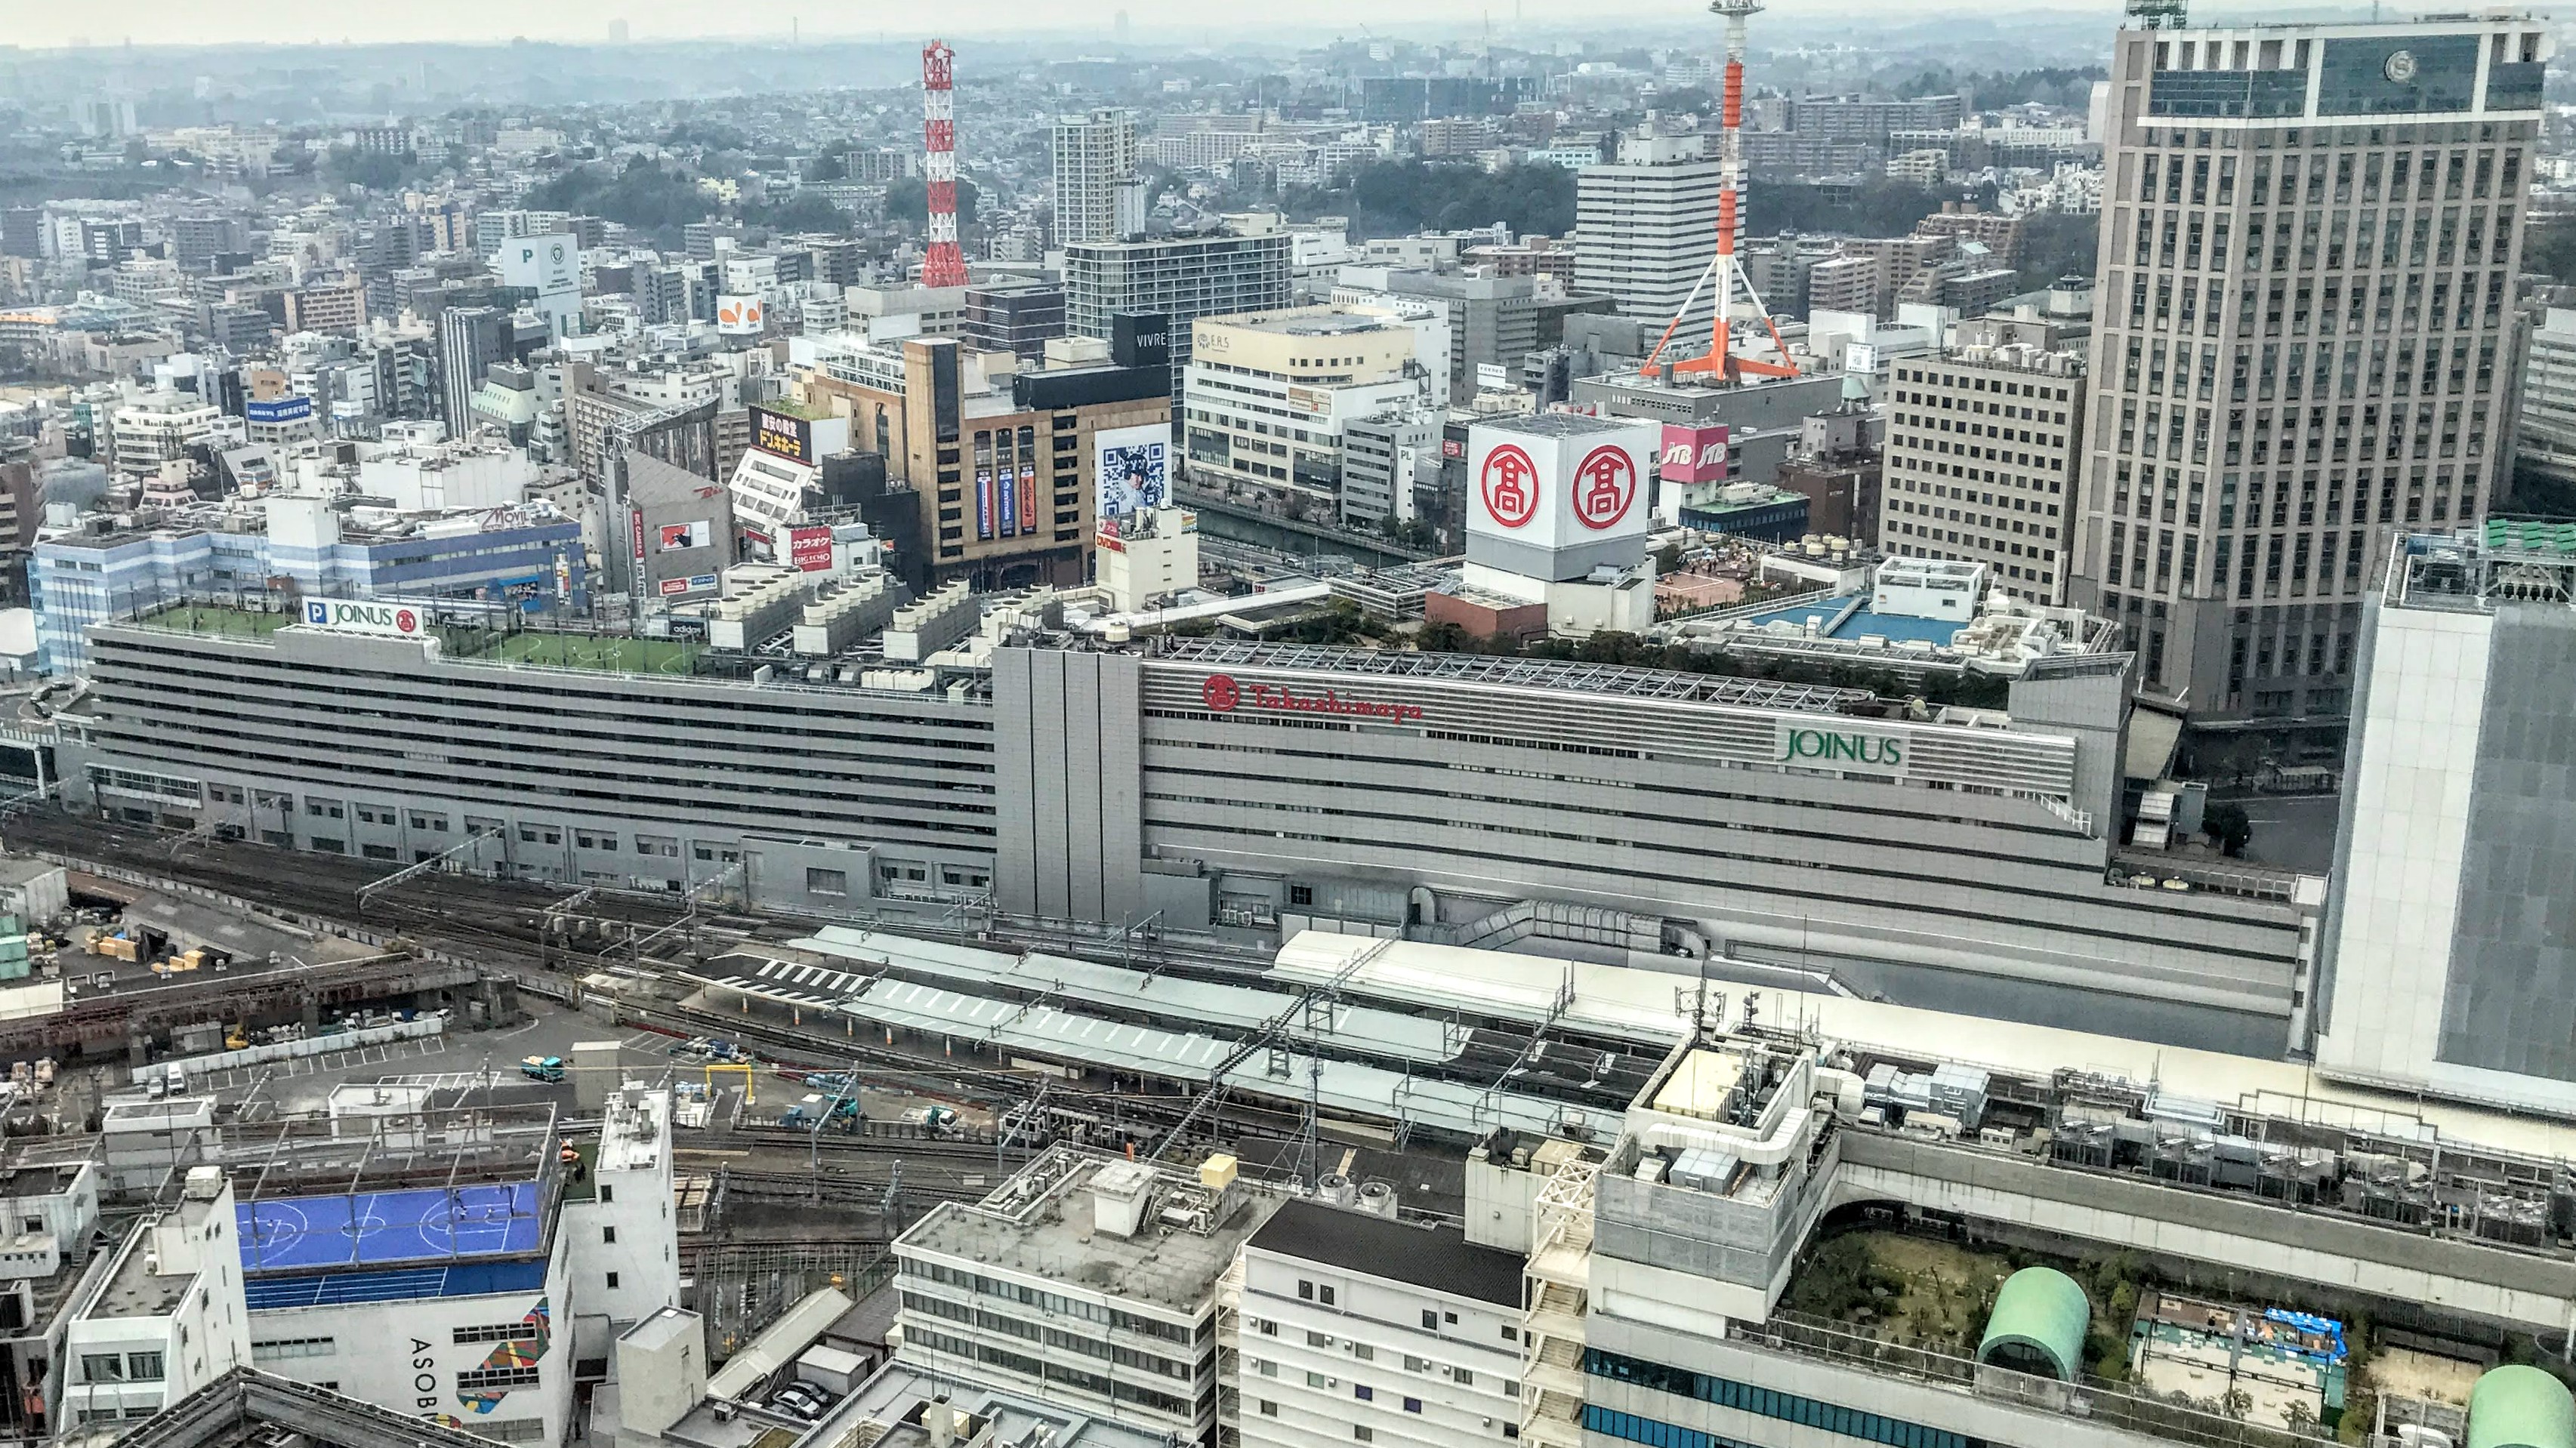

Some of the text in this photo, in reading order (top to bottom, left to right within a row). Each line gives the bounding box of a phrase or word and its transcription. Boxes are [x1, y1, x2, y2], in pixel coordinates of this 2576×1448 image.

[523, 249, 533, 263] P
[1137, 333, 1166, 347] VIVRE
[1661, 442, 1692, 465] JTB
[1696, 442, 1727, 470] JTB
[793, 533, 830, 550] カラオケ
[794, 556, 809, 565] BIG
[312, 605, 322, 621] P
[332, 604, 393, 626] JOINUS
[1249, 684, 1423, 724] Takashimaya
[1775, 729, 1902, 765] JOINUS
